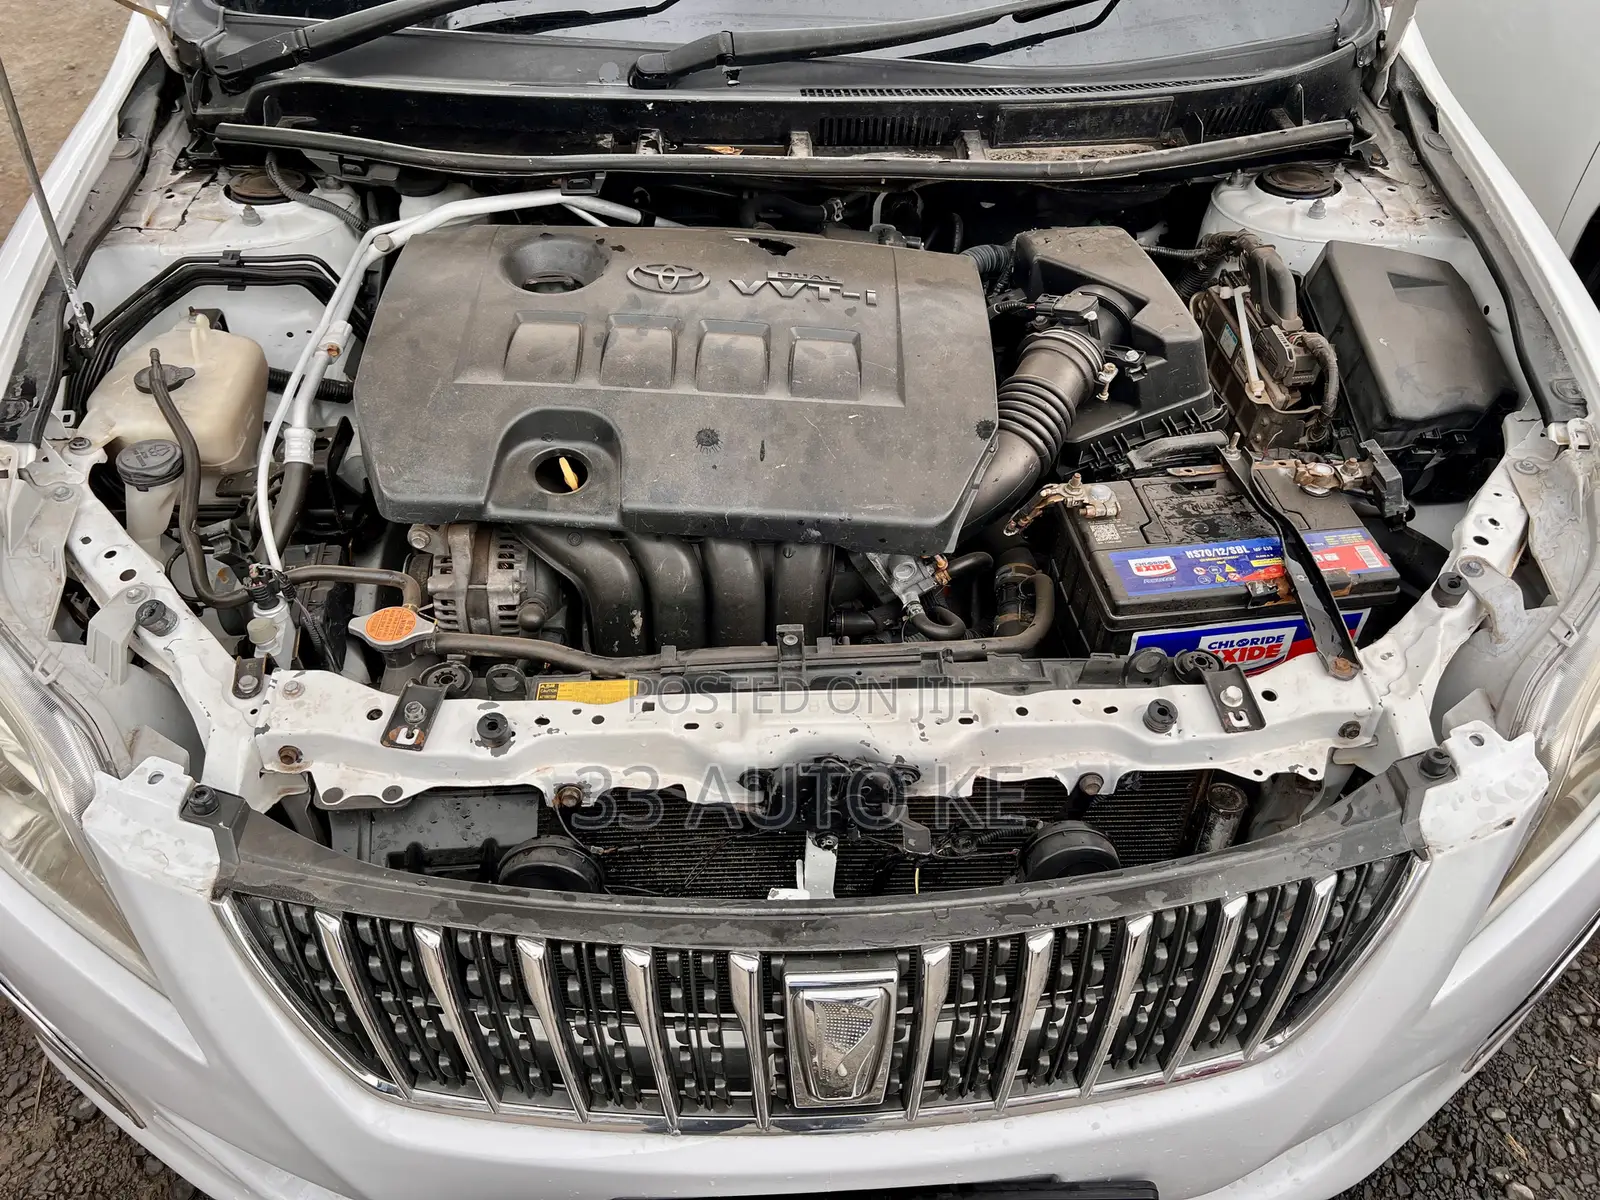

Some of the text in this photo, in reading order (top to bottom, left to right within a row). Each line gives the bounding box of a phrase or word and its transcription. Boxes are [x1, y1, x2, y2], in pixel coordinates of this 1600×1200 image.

[777, 271, 838, 282] DUAL
[1134, 559, 1169, 567] CHLORIDE
[1135, 563, 1172, 572] EXIDE
[1207, 634, 1286, 650] CHLORIDE
[1211, 643, 1284, 663] XIDE
